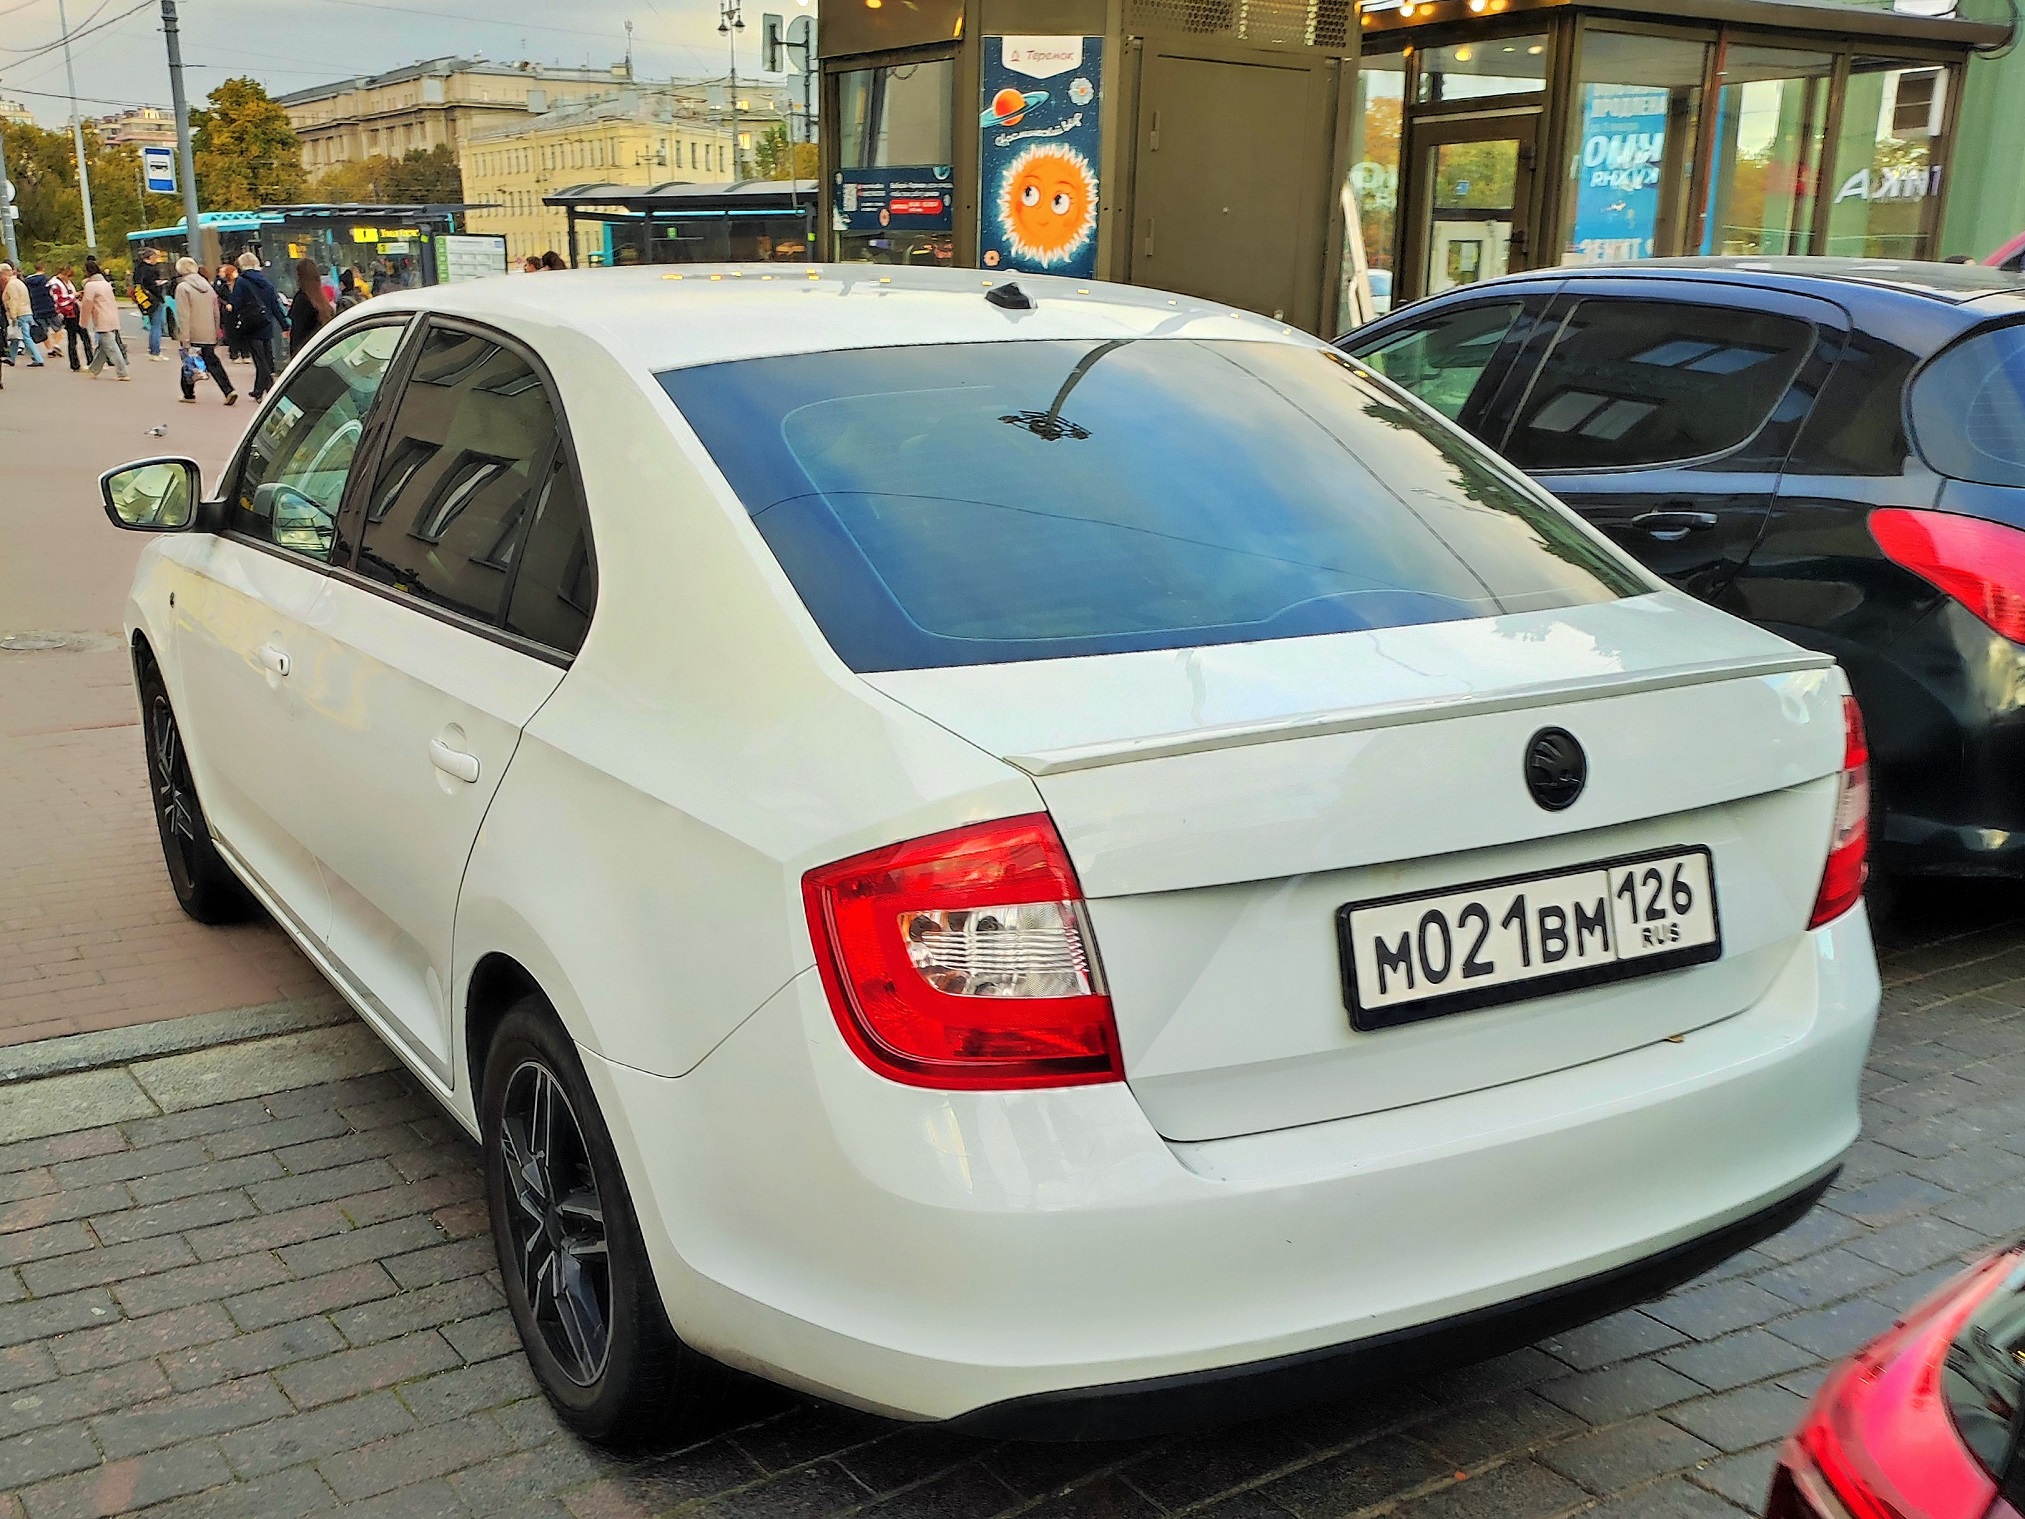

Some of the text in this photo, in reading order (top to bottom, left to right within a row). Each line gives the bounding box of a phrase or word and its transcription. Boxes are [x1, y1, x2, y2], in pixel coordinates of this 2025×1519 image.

[1026, 49, 1074, 62] Теремок
[1617, 862, 1693, 924] 126
[1641, 921, 1681, 949] RUS
